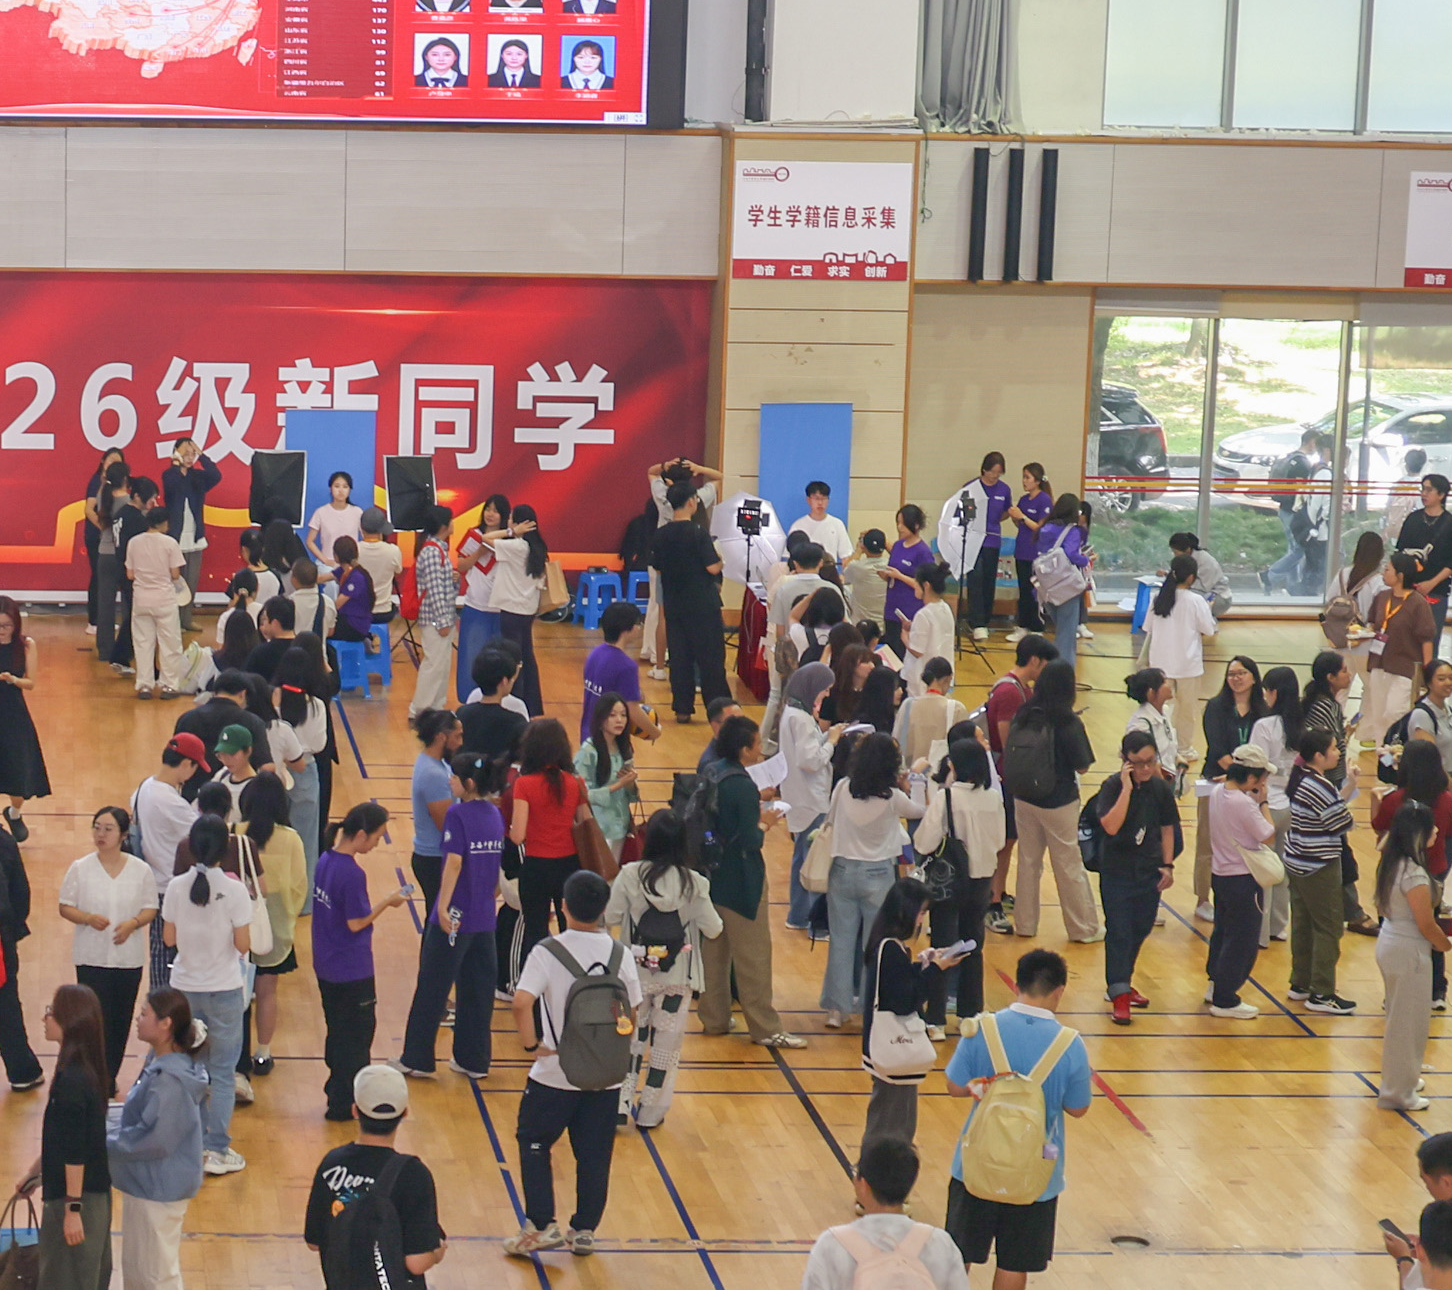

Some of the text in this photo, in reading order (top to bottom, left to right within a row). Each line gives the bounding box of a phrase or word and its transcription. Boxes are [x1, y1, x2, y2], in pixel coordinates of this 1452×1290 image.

[747, 204, 896, 229] 学生学籍信息采集
[752, 264, 888, 278] 勤奋 仁爱 求实 创新
[1424, 273, 1445, 285] 勤奋
